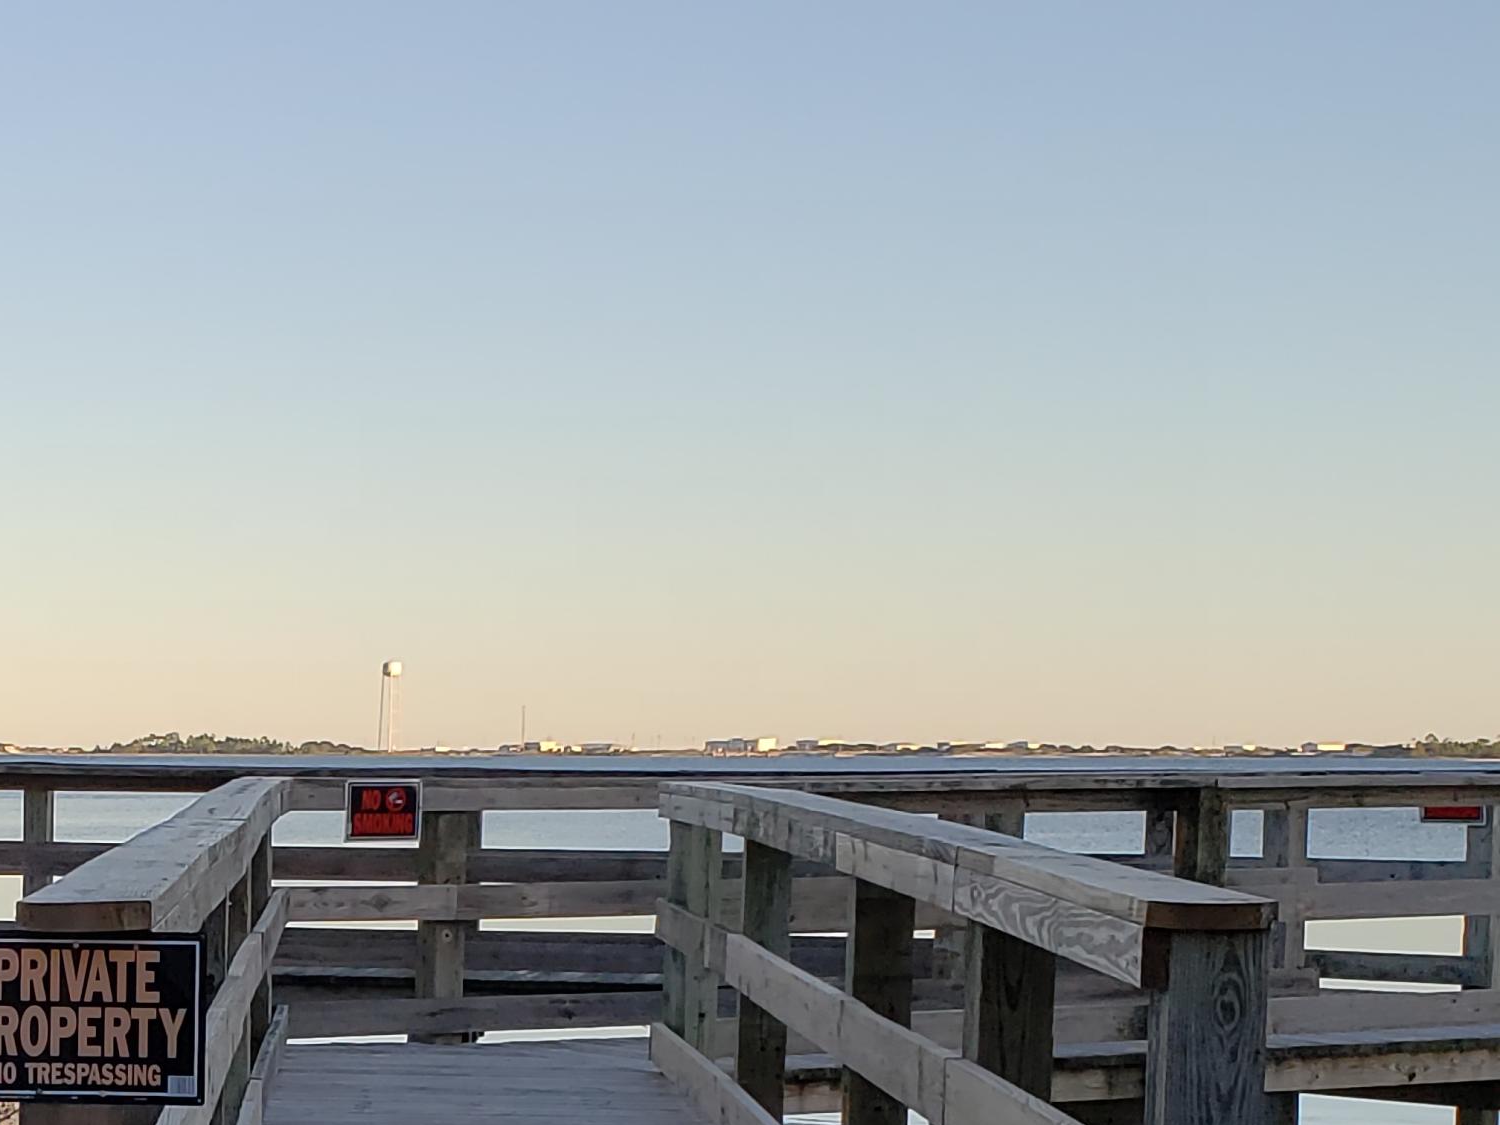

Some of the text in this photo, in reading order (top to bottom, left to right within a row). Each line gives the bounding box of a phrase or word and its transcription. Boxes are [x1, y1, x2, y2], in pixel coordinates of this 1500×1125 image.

[362, 789, 380, 810] NO
[353, 813, 413, 834] SMOKING
[24, 1062, 162, 1086] TRESPASSING
